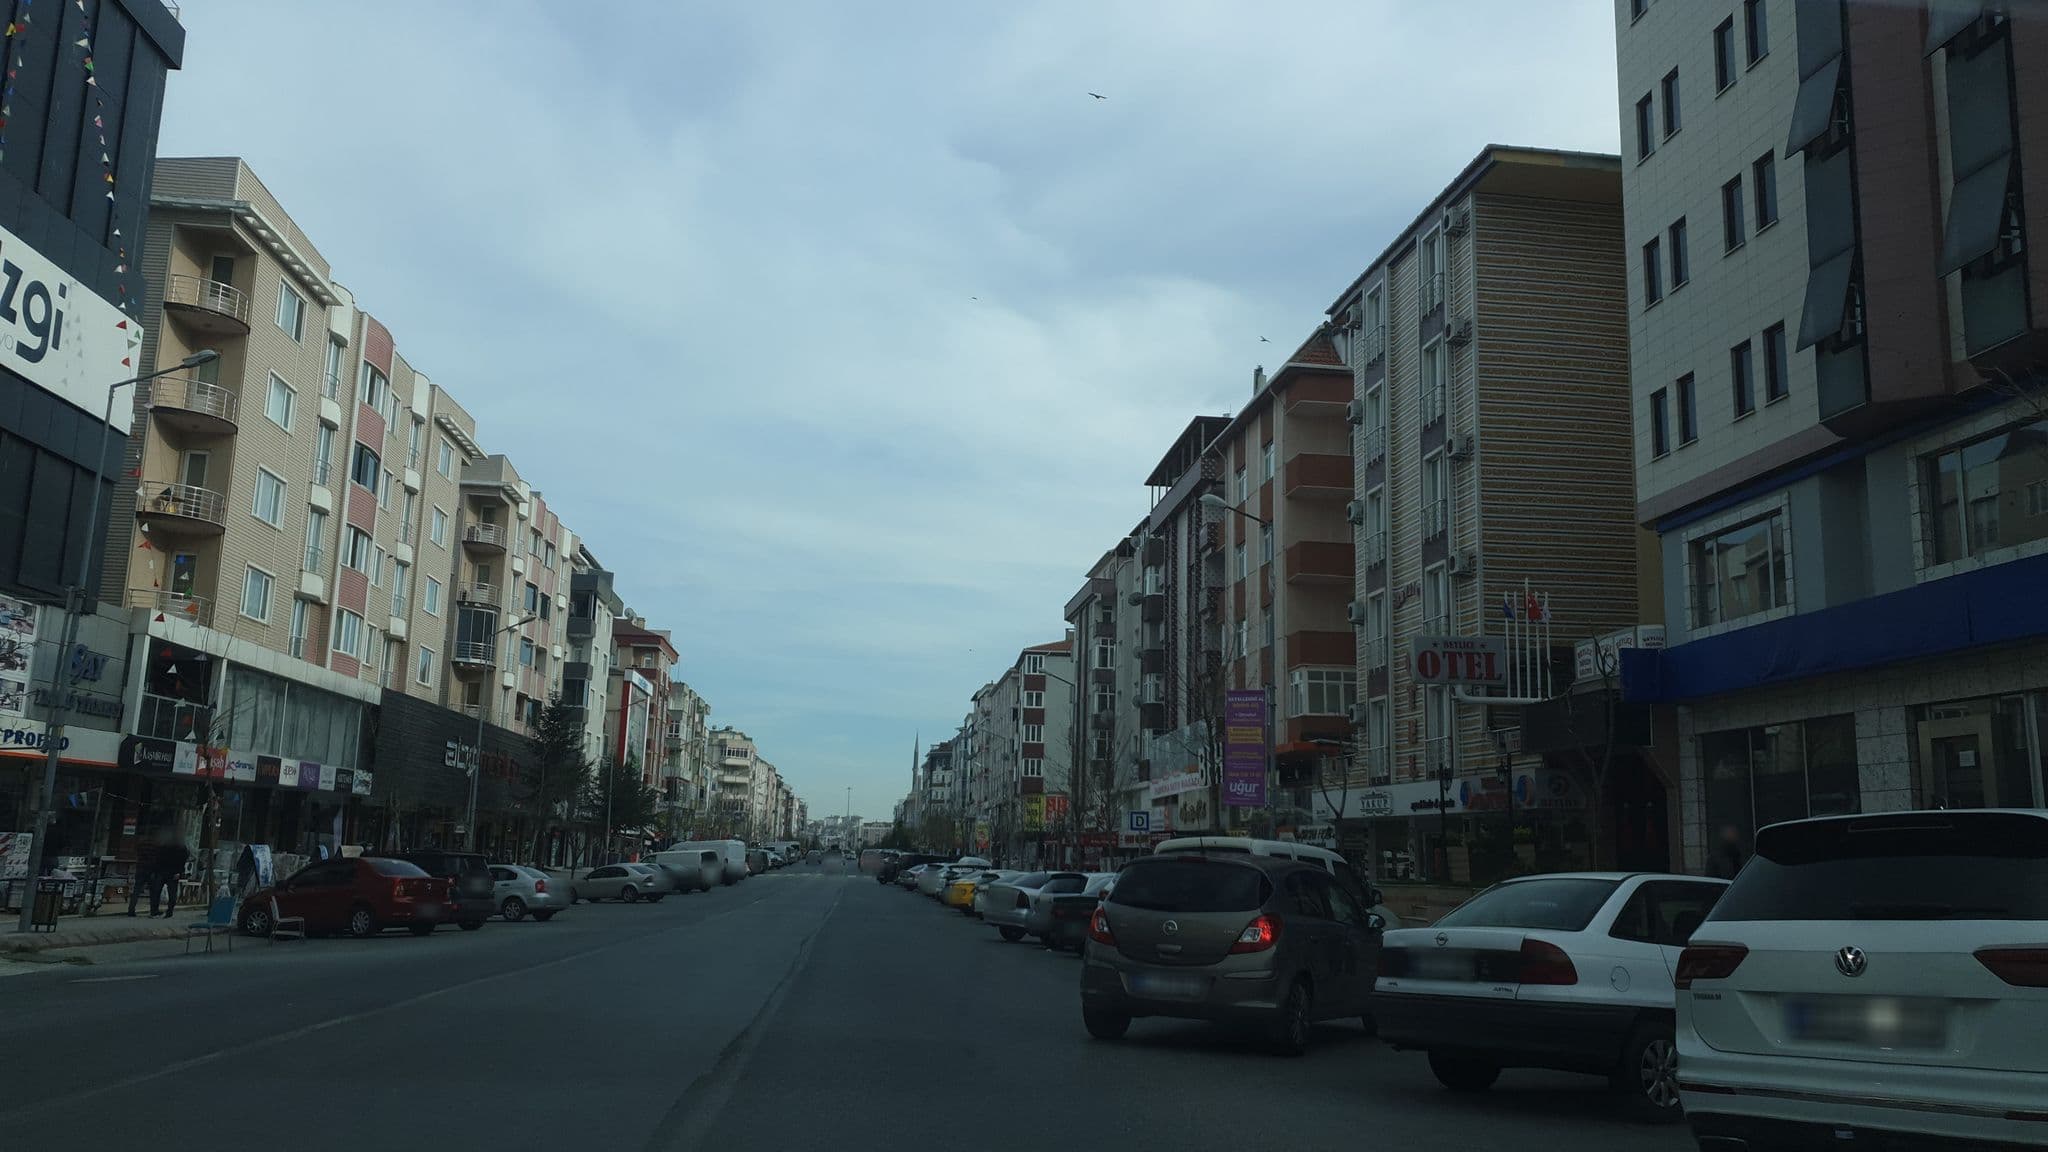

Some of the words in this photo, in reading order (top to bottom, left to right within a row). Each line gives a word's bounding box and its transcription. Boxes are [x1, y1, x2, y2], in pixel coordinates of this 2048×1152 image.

[1418, 650, 1502, 680] OTEL
[3, 729, 69, 752] PROFO
[1229, 780, 1260, 795] uğur
